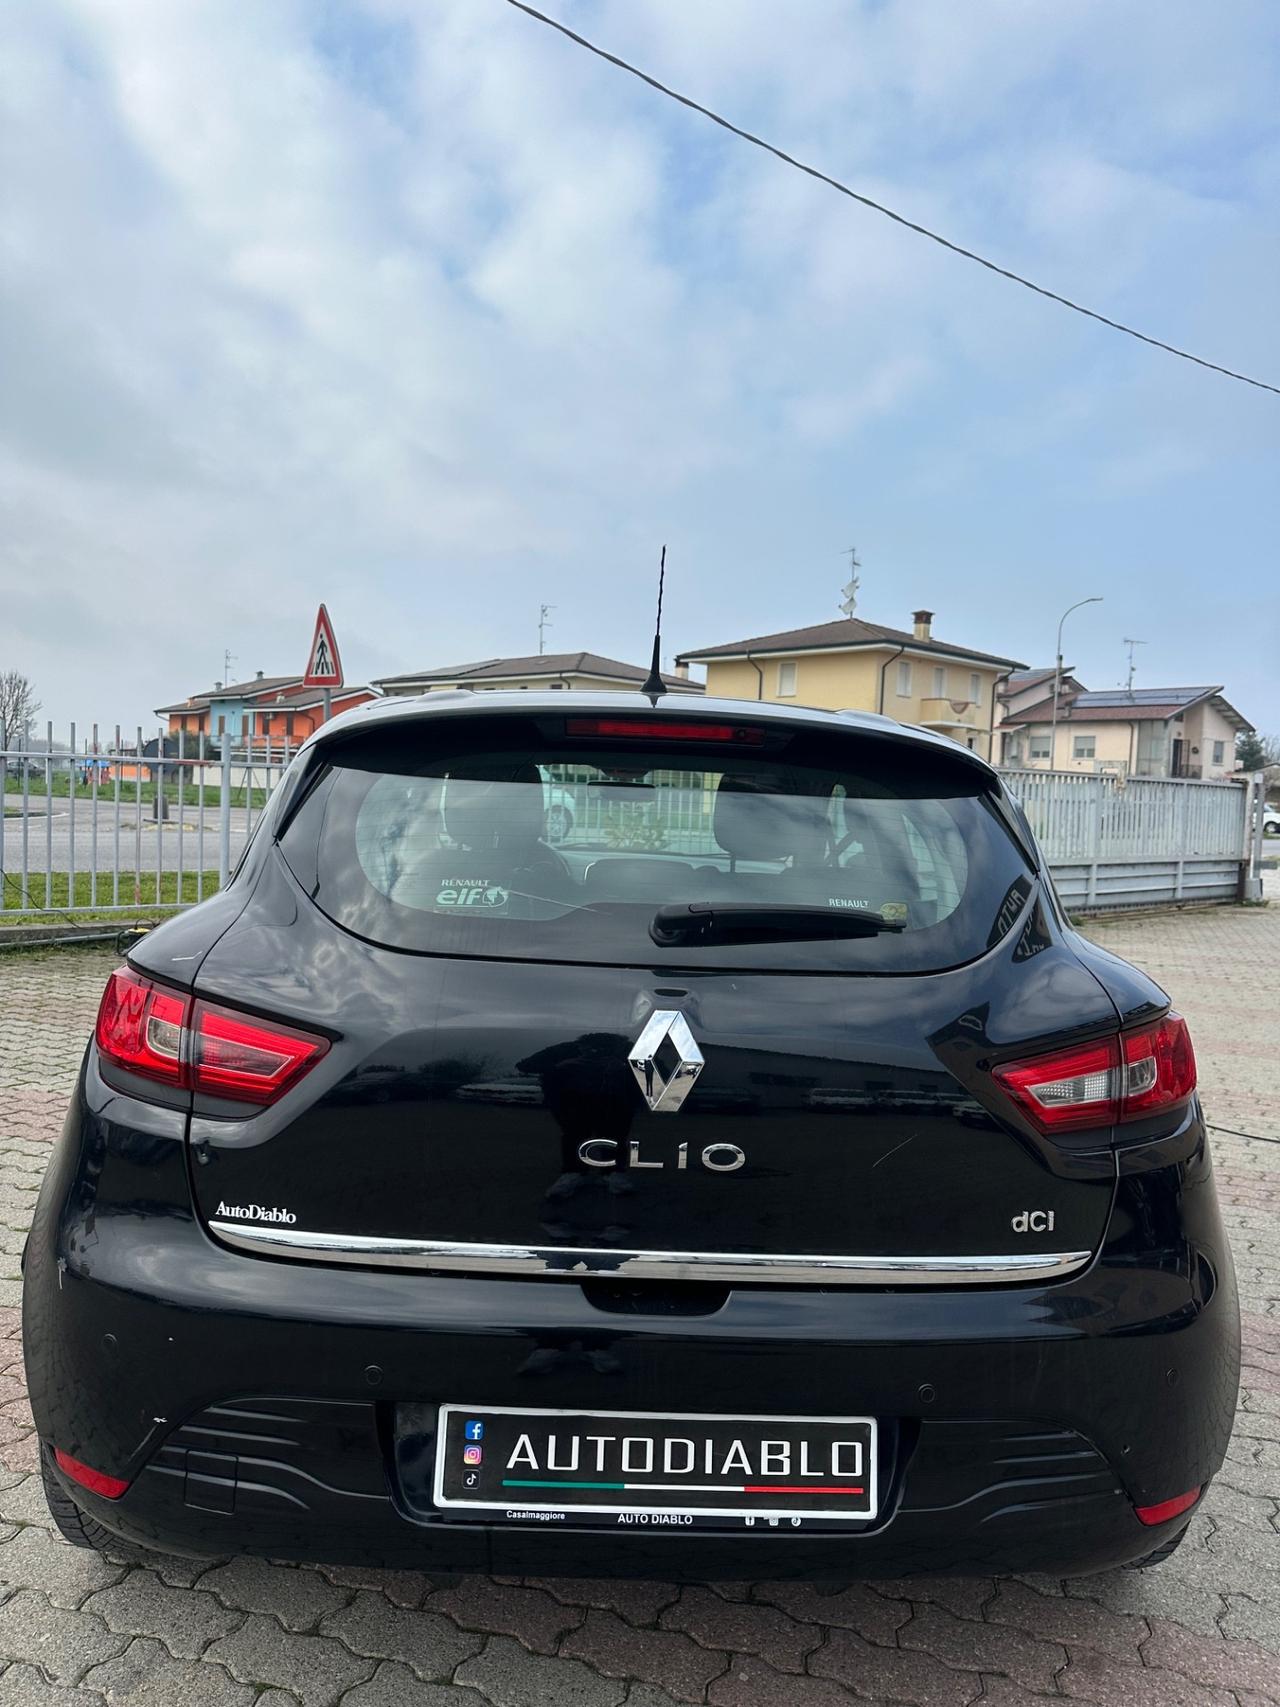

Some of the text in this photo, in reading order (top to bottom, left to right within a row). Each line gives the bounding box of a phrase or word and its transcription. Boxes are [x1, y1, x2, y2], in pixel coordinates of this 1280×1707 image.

[441, 879, 490, 887] RENAULT
[436, 888, 483, 905] elf
[828, 898, 870, 909] RENAULT
[215, 1200, 297, 1224] AutoDiablo
[505, 1433, 864, 1477] AUTODIABLO
[506, 1510, 566, 1521] Casalmaggiore
[617, 1513, 693, 1526] AUTO DIABLO
